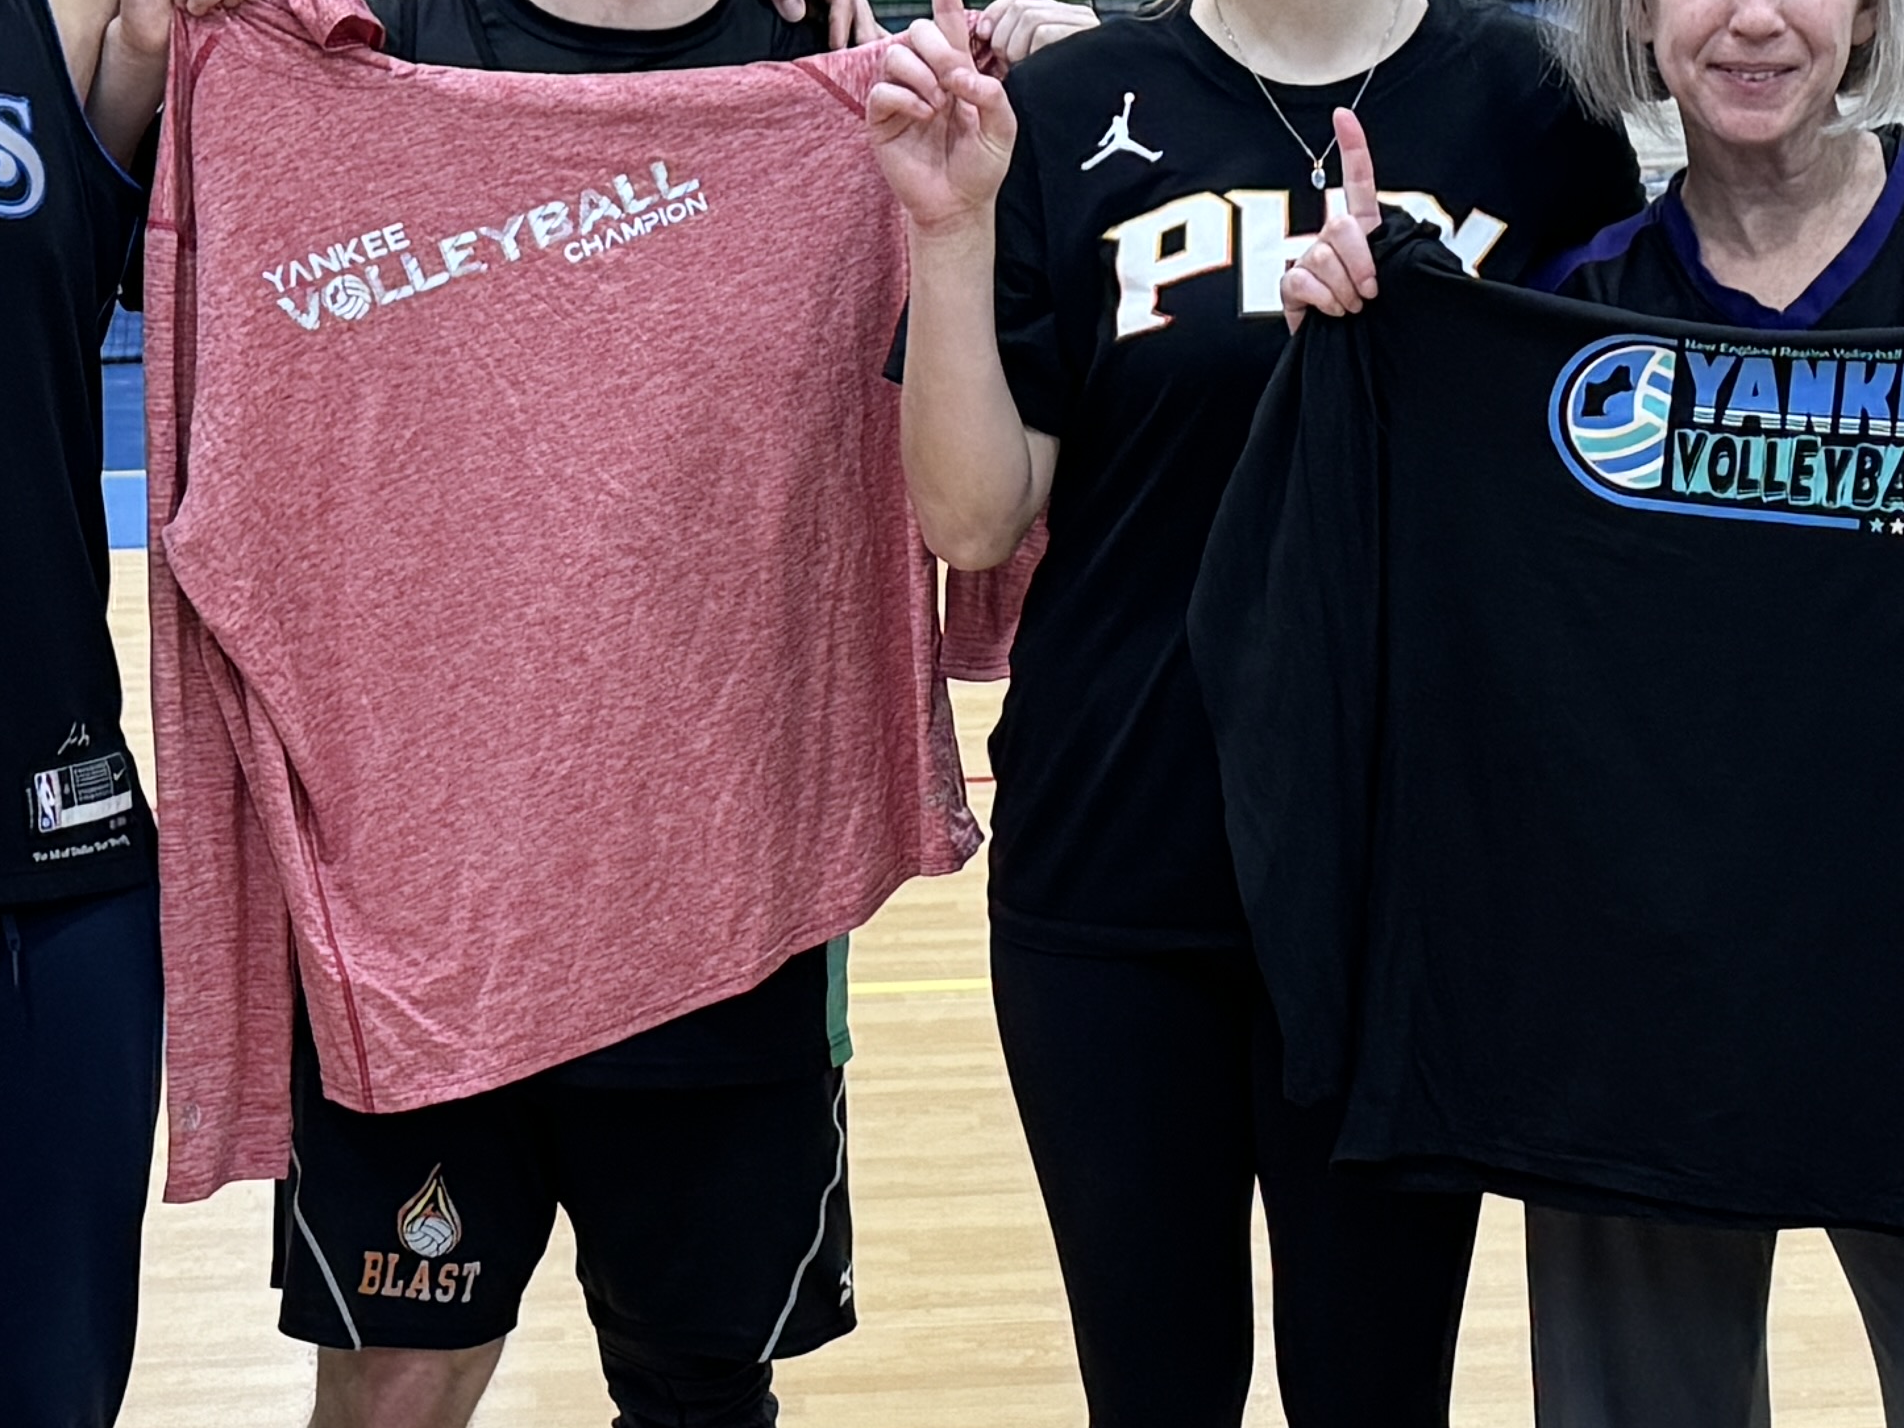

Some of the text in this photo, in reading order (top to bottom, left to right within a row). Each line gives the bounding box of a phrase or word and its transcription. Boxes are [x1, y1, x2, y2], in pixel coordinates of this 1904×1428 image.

[262, 222, 410, 293] YANKEE
[277, 160, 700, 331] VOLLEYBALL
[563, 192, 709, 263] CHAMPION
[358, 1250, 481, 1303] BLAST
